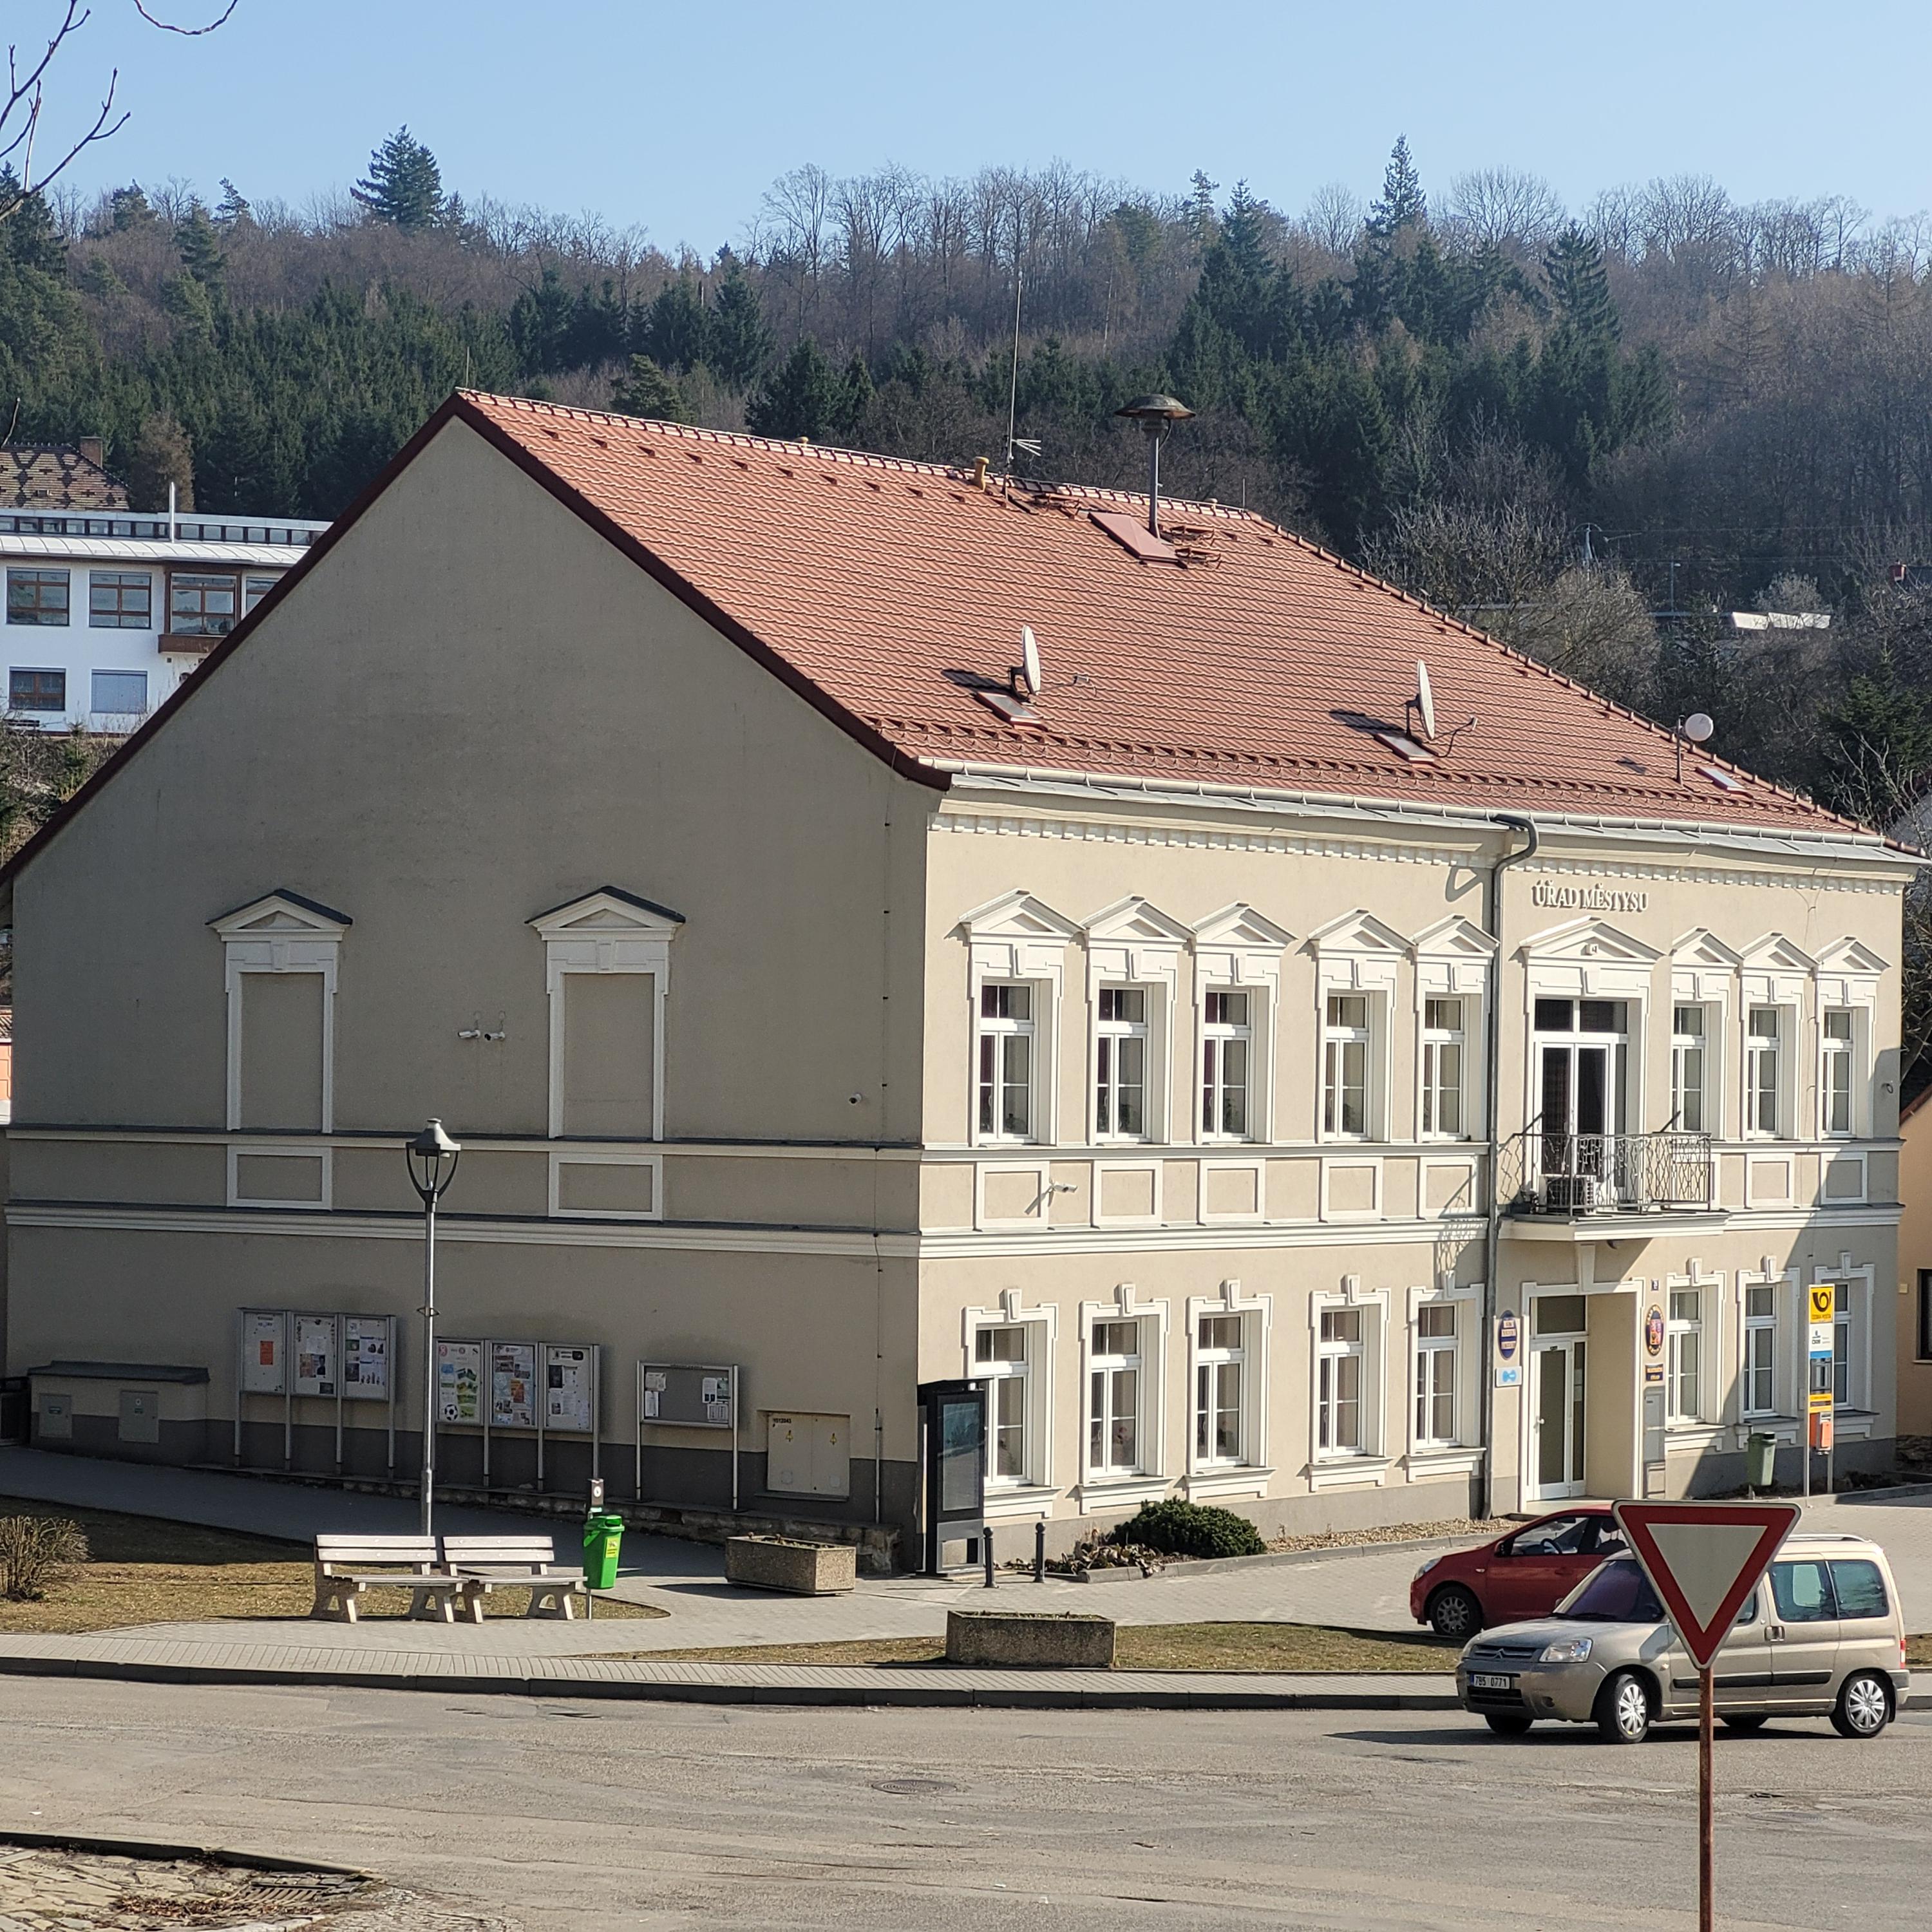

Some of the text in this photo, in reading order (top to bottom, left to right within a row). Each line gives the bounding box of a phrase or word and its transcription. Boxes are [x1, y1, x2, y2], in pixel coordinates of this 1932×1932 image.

[1531, 880, 1649, 913] ÚŘAD MĚSTYSU
[1490, 1677, 1506, 1687] 0771
